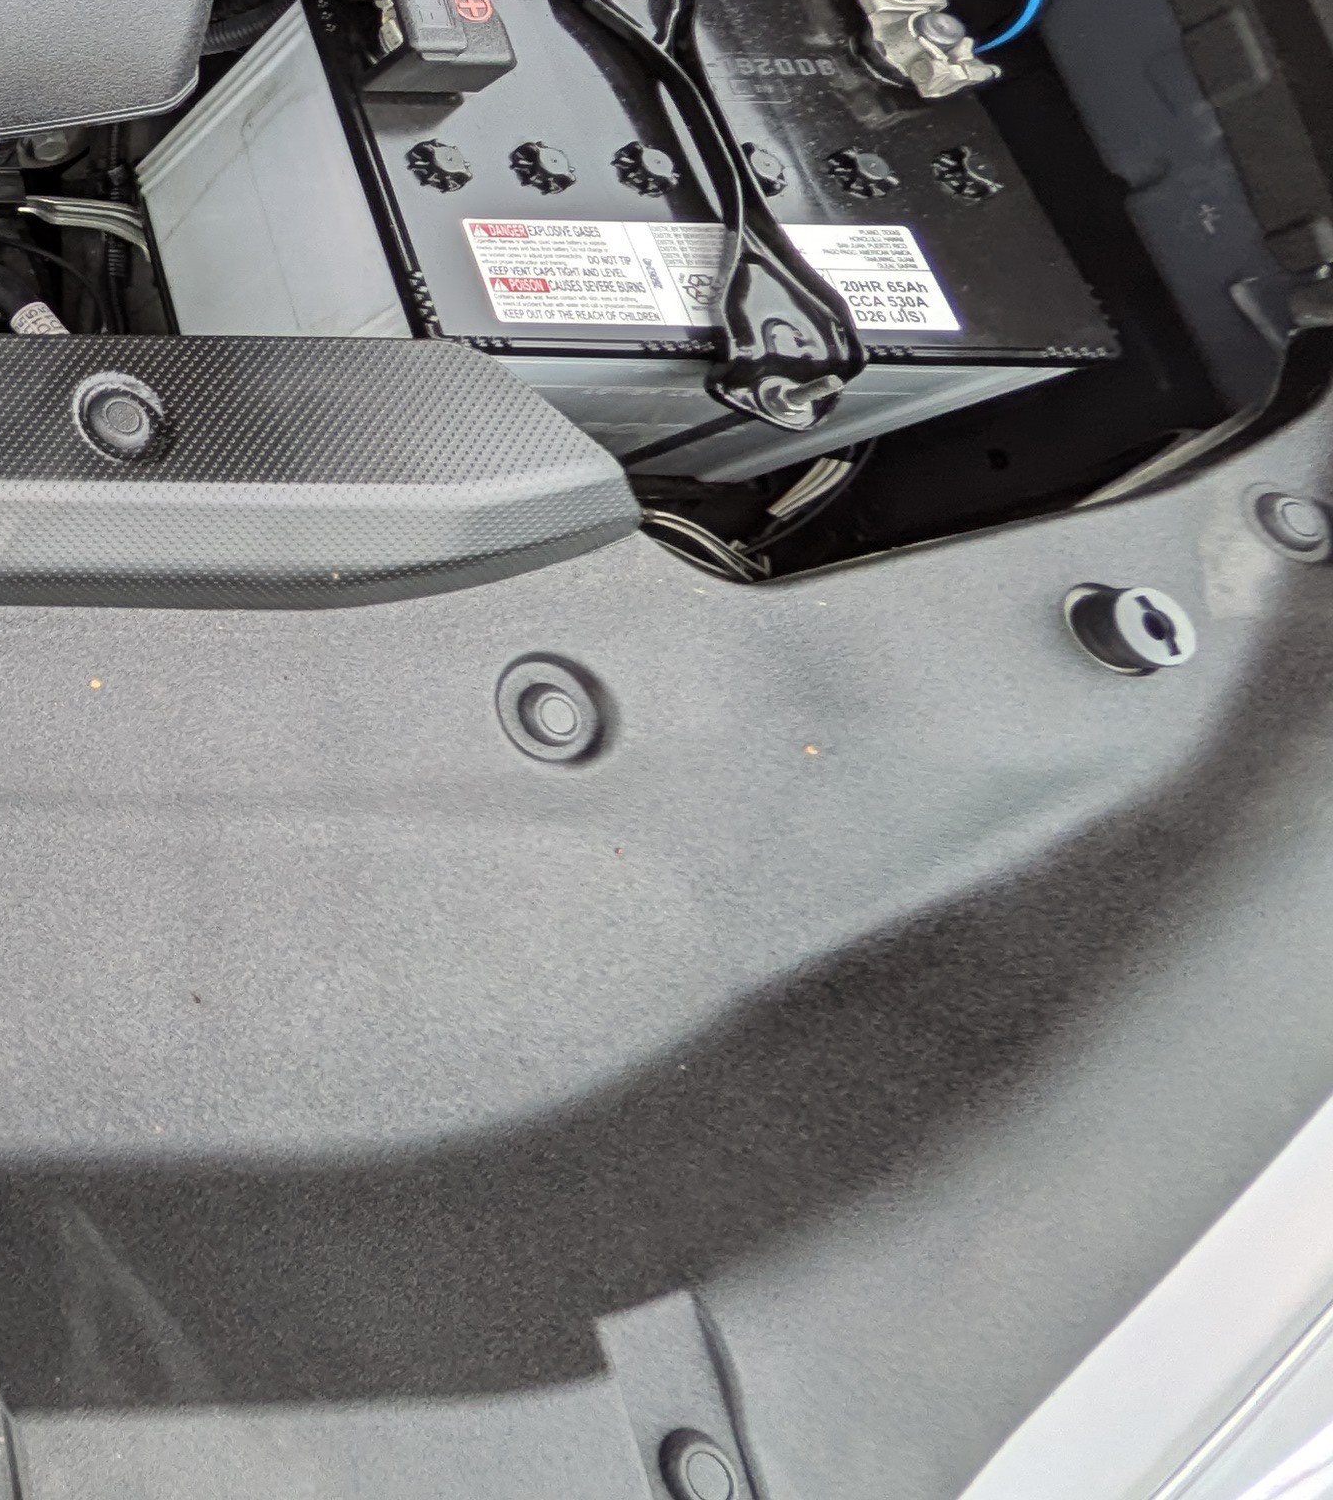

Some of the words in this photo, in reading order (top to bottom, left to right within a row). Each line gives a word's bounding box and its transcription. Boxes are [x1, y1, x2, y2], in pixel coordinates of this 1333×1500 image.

[488, 224, 528, 238] DANGER
[528, 225, 573, 238] EXPLOSIVE
[573, 226, 602, 239] GASES
[588, 255, 600, 264] DO
[601, 256, 618, 265] NOT
[619, 256, 631, 265] TIP
[488, 266, 509, 276] KEEP
[510, 267, 531, 277] VENT
[532, 267, 556, 277] CAPS
[556, 267, 581, 277] TIGHT
[583, 268, 601, 278] AND
[602, 268, 627, 278] LEVEL
[509, 278, 544, 291] POISON
[549, 280, 583, 292] CAUSES
[583, 280, 615, 292] SEVERE
[616, 281, 647, 293] BURNS
[840, 280, 884, 292] 20HR
[887, 281, 929, 293] 65Ah
[849, 295, 885, 307] CCA
[888, 296, 929, 308] 530A
[503, 309, 524, 319] KEEP
[526, 309, 543, 320] OUT
[544, 310, 556, 320] OF
[557, 310, 575, 320] THE
[576, 311, 605, 321] REACH
[606, 311, 618, 321] OF
[619, 312, 662, 322] CHILDREN
[855, 310, 886, 322] D26
[890, 310, 927, 323] (JIS)
